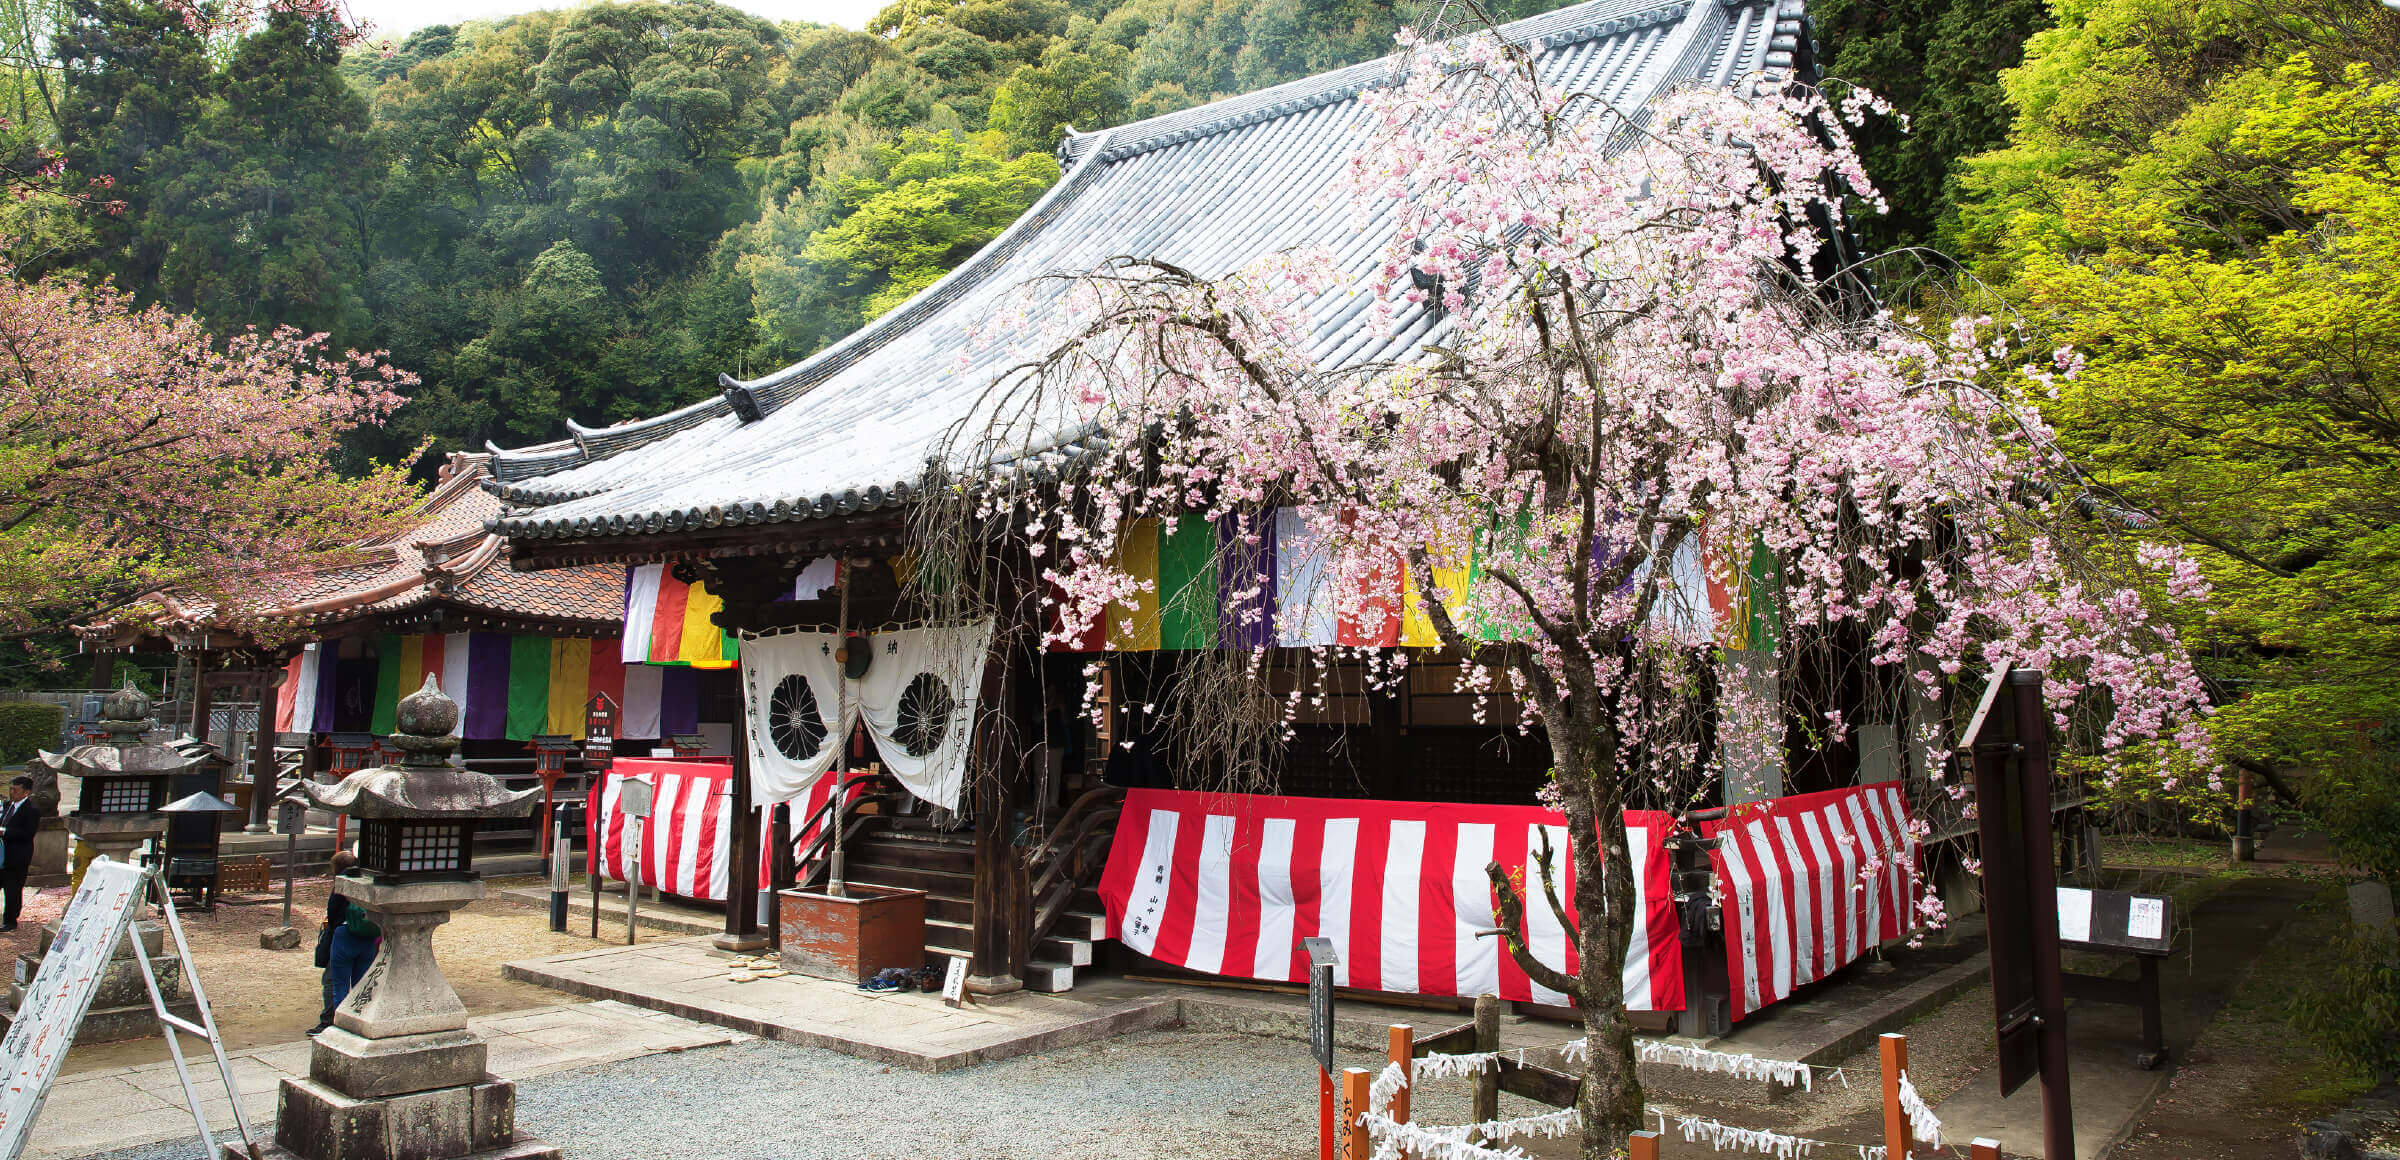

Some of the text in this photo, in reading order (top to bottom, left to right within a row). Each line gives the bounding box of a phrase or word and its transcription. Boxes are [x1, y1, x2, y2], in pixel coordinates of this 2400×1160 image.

[886, 639, 898, 656] 納
[36, 892, 129, 1081] 四月十八日
